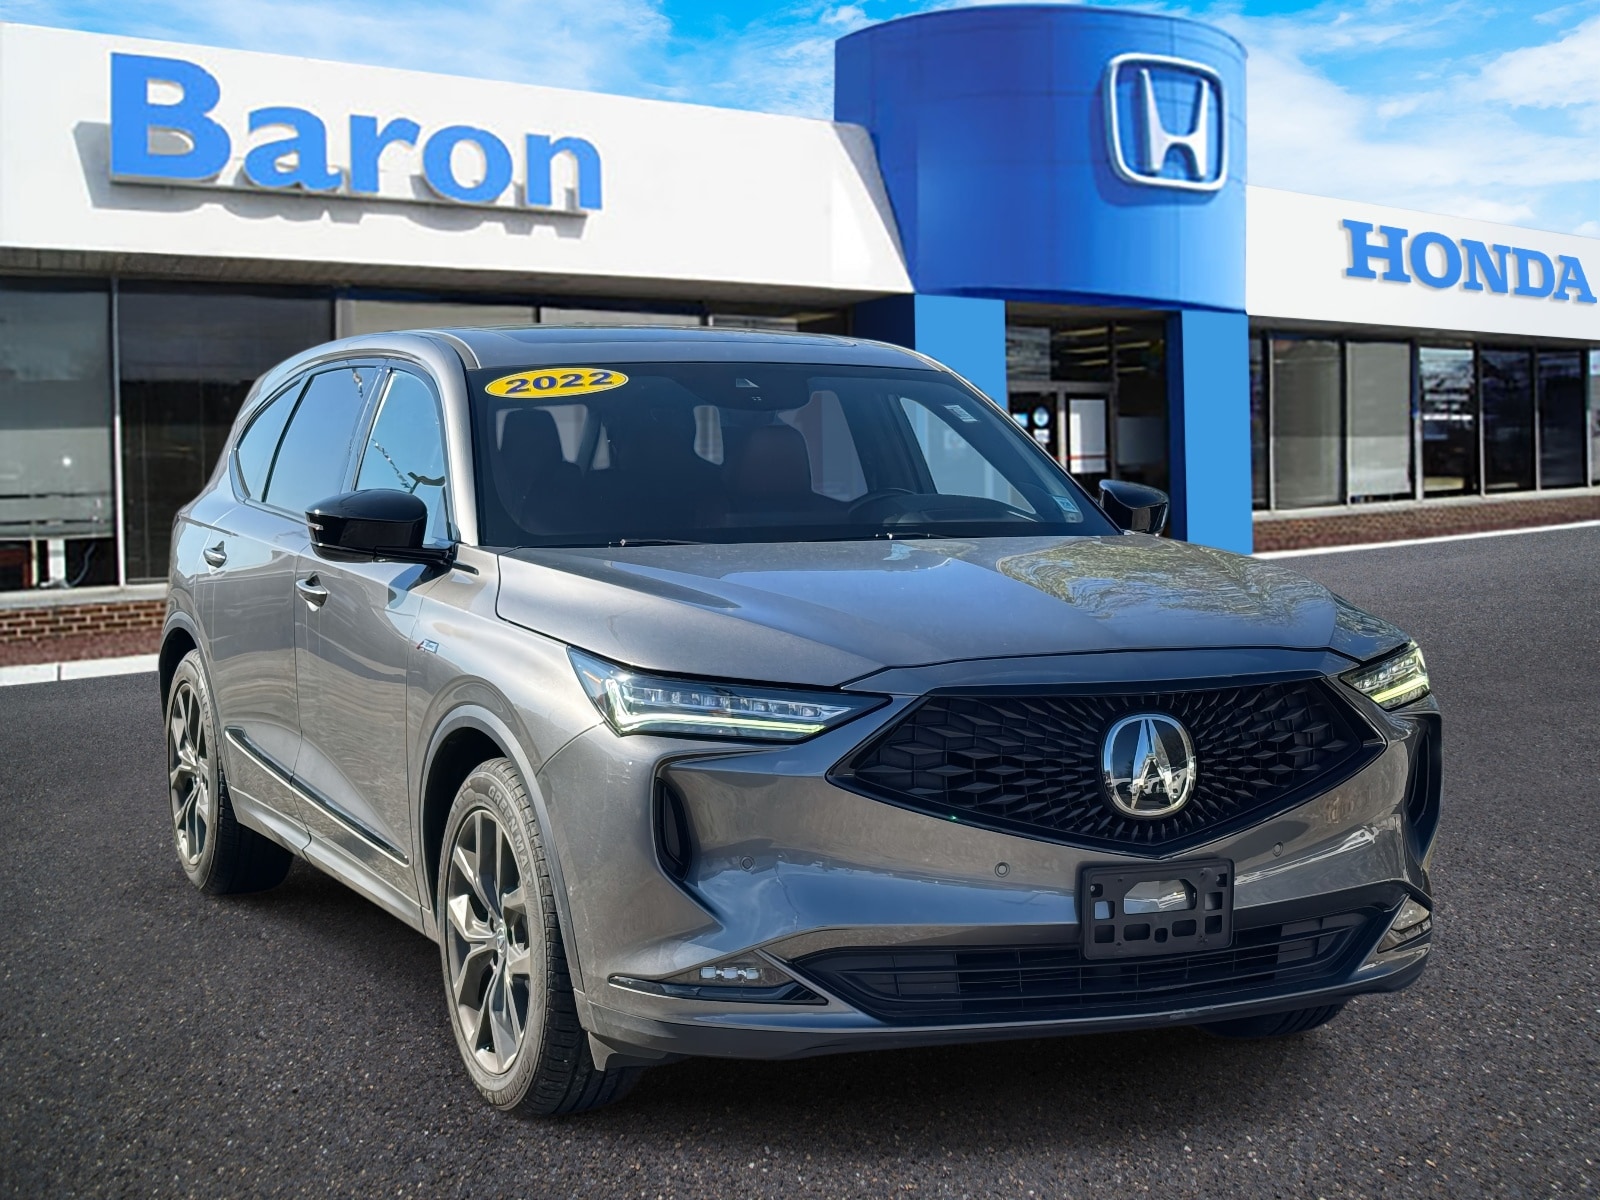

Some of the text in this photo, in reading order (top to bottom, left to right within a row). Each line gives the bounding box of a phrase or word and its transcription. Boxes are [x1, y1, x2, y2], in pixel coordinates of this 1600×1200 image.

[109, 52, 603, 211] Baron
[1342, 218, 1598, 304] HONDA
[504, 371, 614, 395] 2022
